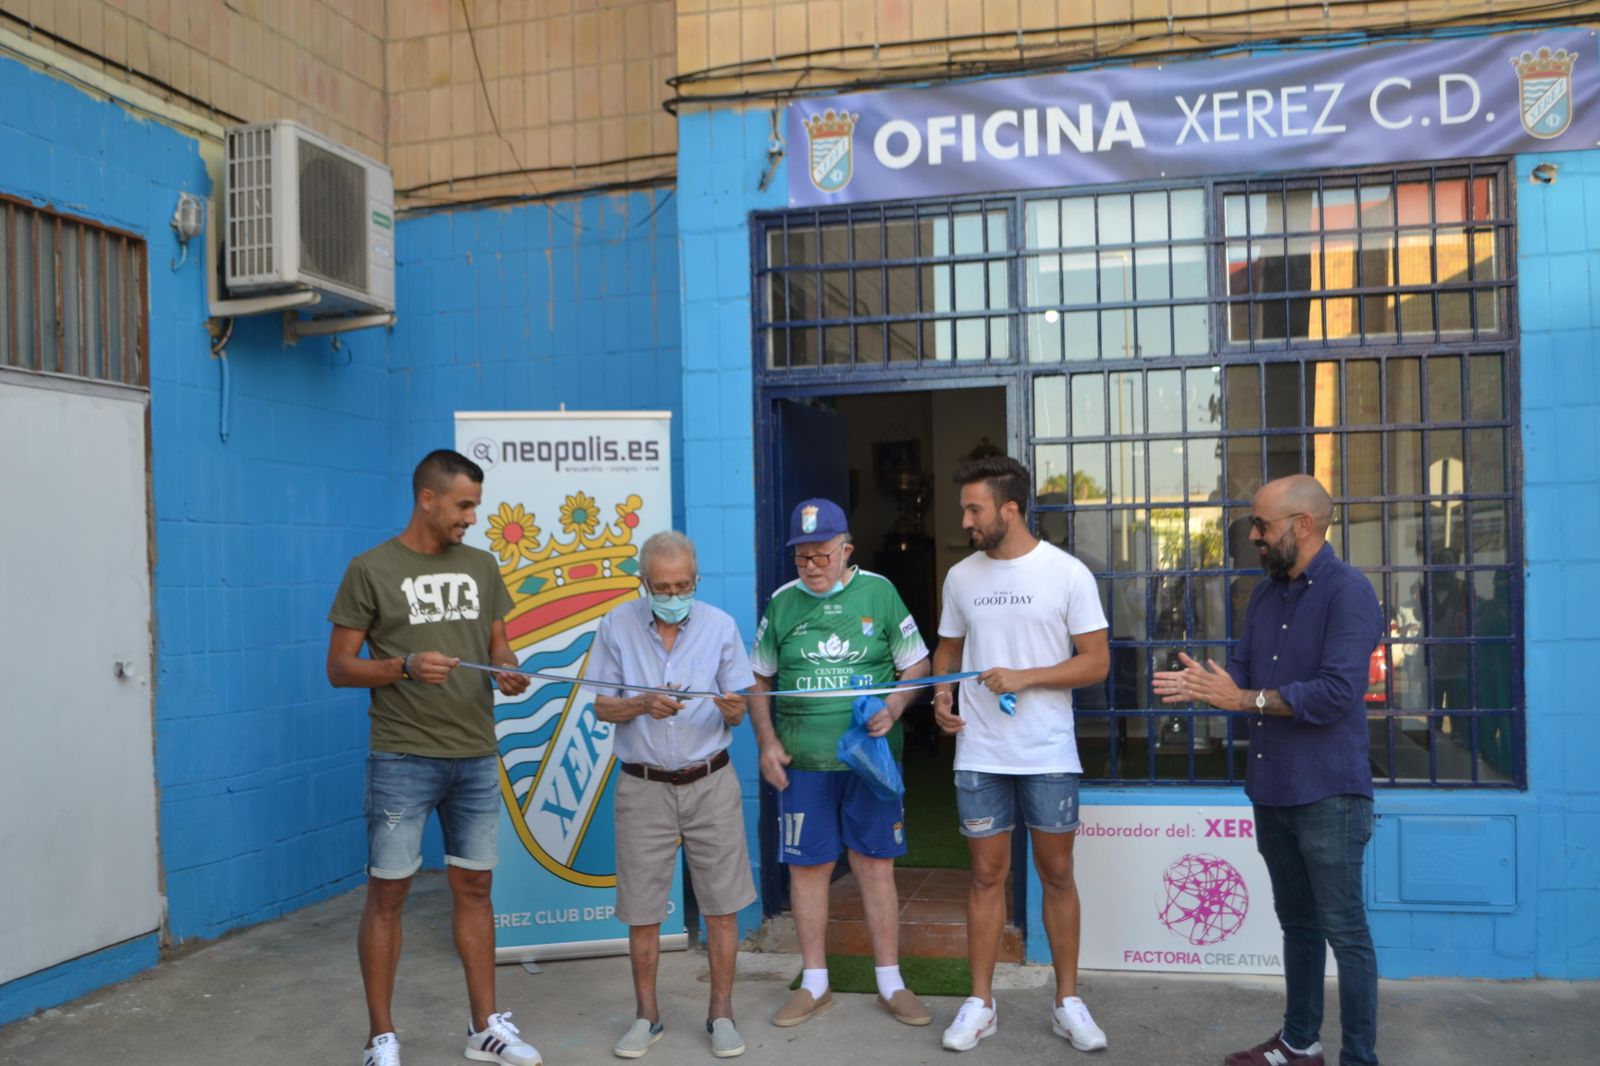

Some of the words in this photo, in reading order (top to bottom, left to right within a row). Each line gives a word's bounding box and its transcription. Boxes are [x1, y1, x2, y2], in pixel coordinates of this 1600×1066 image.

[873, 100, 1146, 169] OFICINA
[1174, 82, 1347, 146] XEREZ
[1369, 73, 1496, 130] C.D.
[502, 436, 660, 472] neopolis.es
[973, 596, 1007, 606] GOOD
[1010, 595, 1034, 605] DAY
[814, 667, 854, 676] CENTROS
[540, 702, 609, 841] XER
[1074, 822, 1161, 838] olaborador
[1165, 823, 1196, 838] del:
[1203, 818, 1254, 838] XER
[494, 911, 532, 928] EREZ
[535, 907, 580, 925] CLUB
